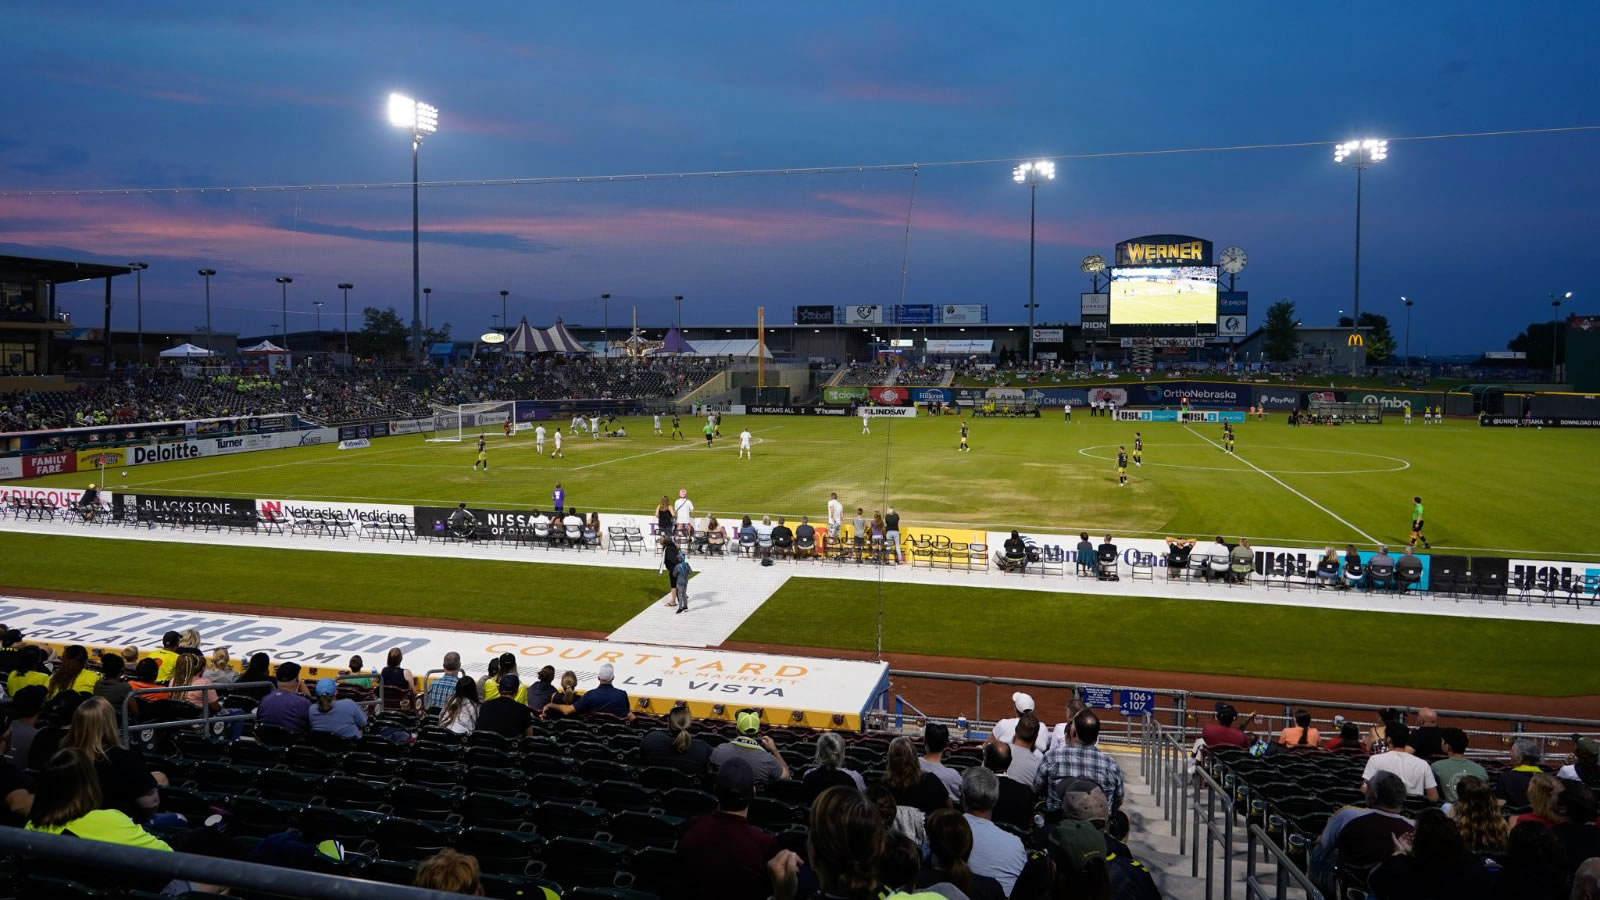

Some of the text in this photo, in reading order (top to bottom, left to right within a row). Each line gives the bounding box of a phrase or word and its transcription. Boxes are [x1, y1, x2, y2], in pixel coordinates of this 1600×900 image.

[1127, 241, 1203, 264] WERNER
[1163, 389, 1237, 399] OrthoNebraska
[1270, 396, 1295, 404] PayPal
[216, 438, 243, 449] Turner
[31, 455, 67, 466] FAMILY
[145, 500, 231, 515] BLACKSTONE
[284, 505, 407, 523] Nebraska Medicine
[276, 626, 432, 654] Fun
[485, 643, 809, 678] COURTYARD
[695, 672, 801, 686] MARRIOTT
[622, 676, 785, 698] LA VISTA
[1129, 692, 1146, 701] 106
[1129, 701, 1146, 710] 107
